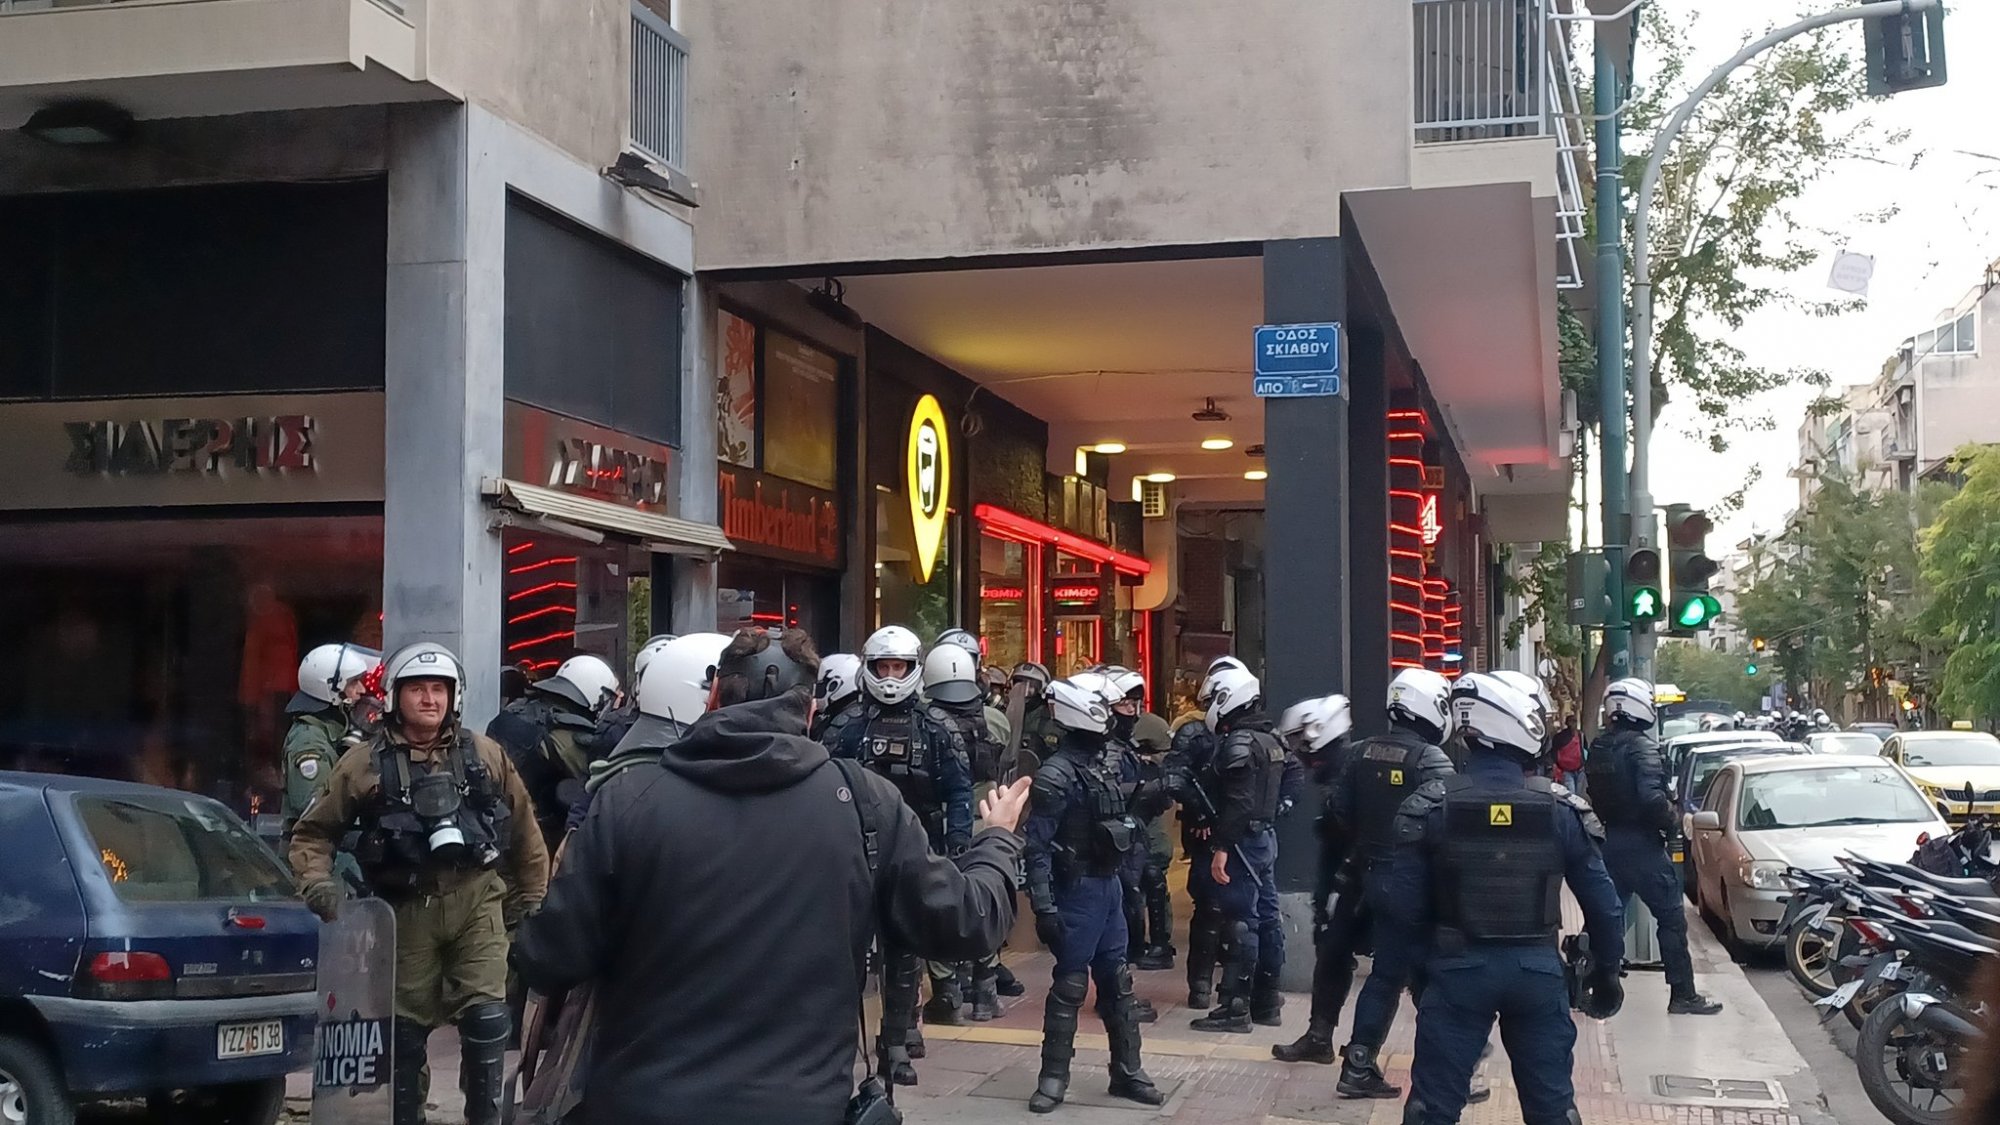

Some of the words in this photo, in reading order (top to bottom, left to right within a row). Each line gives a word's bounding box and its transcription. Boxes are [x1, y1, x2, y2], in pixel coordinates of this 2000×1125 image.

[1275, 329, 1318, 340] ΟΔΟΣ
[1266, 343, 1329, 355] ΣΚΙΑΘΟΥ
[1257, 382, 1283, 393] ΑΠΟ
[720, 470, 817, 553] Timberland
[1054, 587, 1099, 598] KIMBO
[314, 1056, 377, 1085] OLICE
